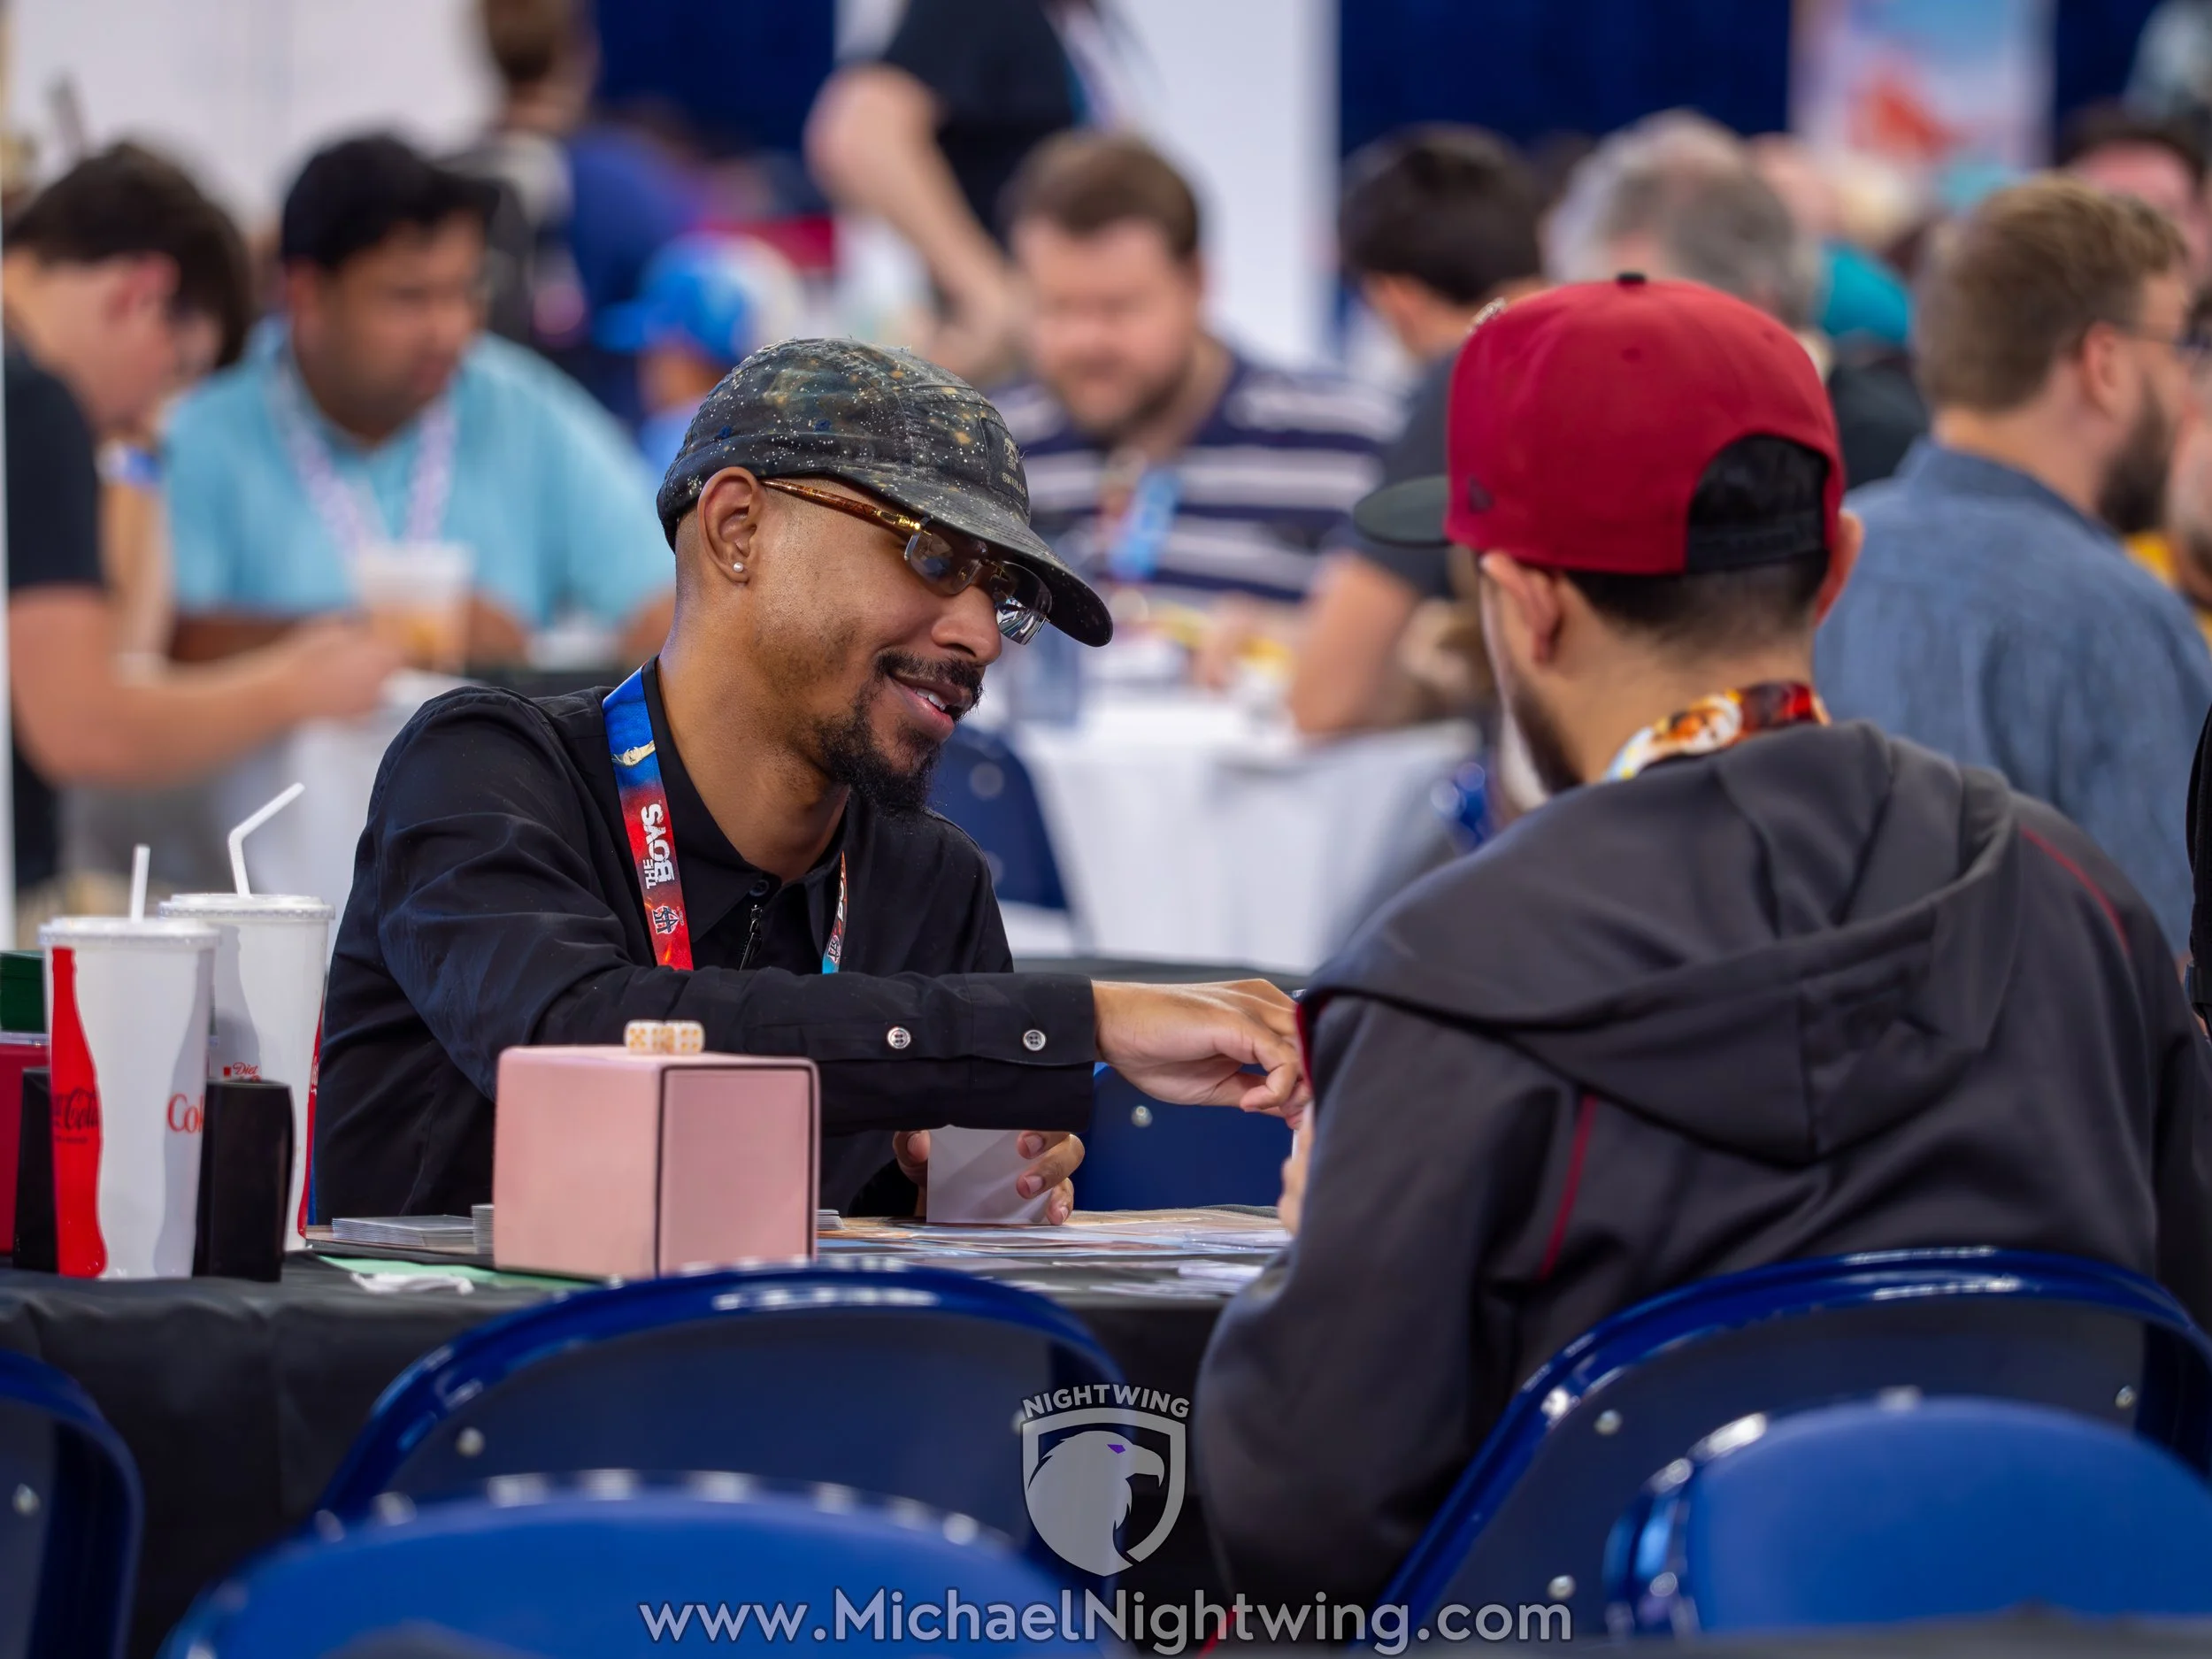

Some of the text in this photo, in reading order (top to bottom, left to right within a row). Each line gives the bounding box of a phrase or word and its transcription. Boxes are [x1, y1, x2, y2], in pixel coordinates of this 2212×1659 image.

[641, 803, 675, 883] BOYS
[642, 858, 657, 889] THE
[232, 1061, 259, 1075] Diet
